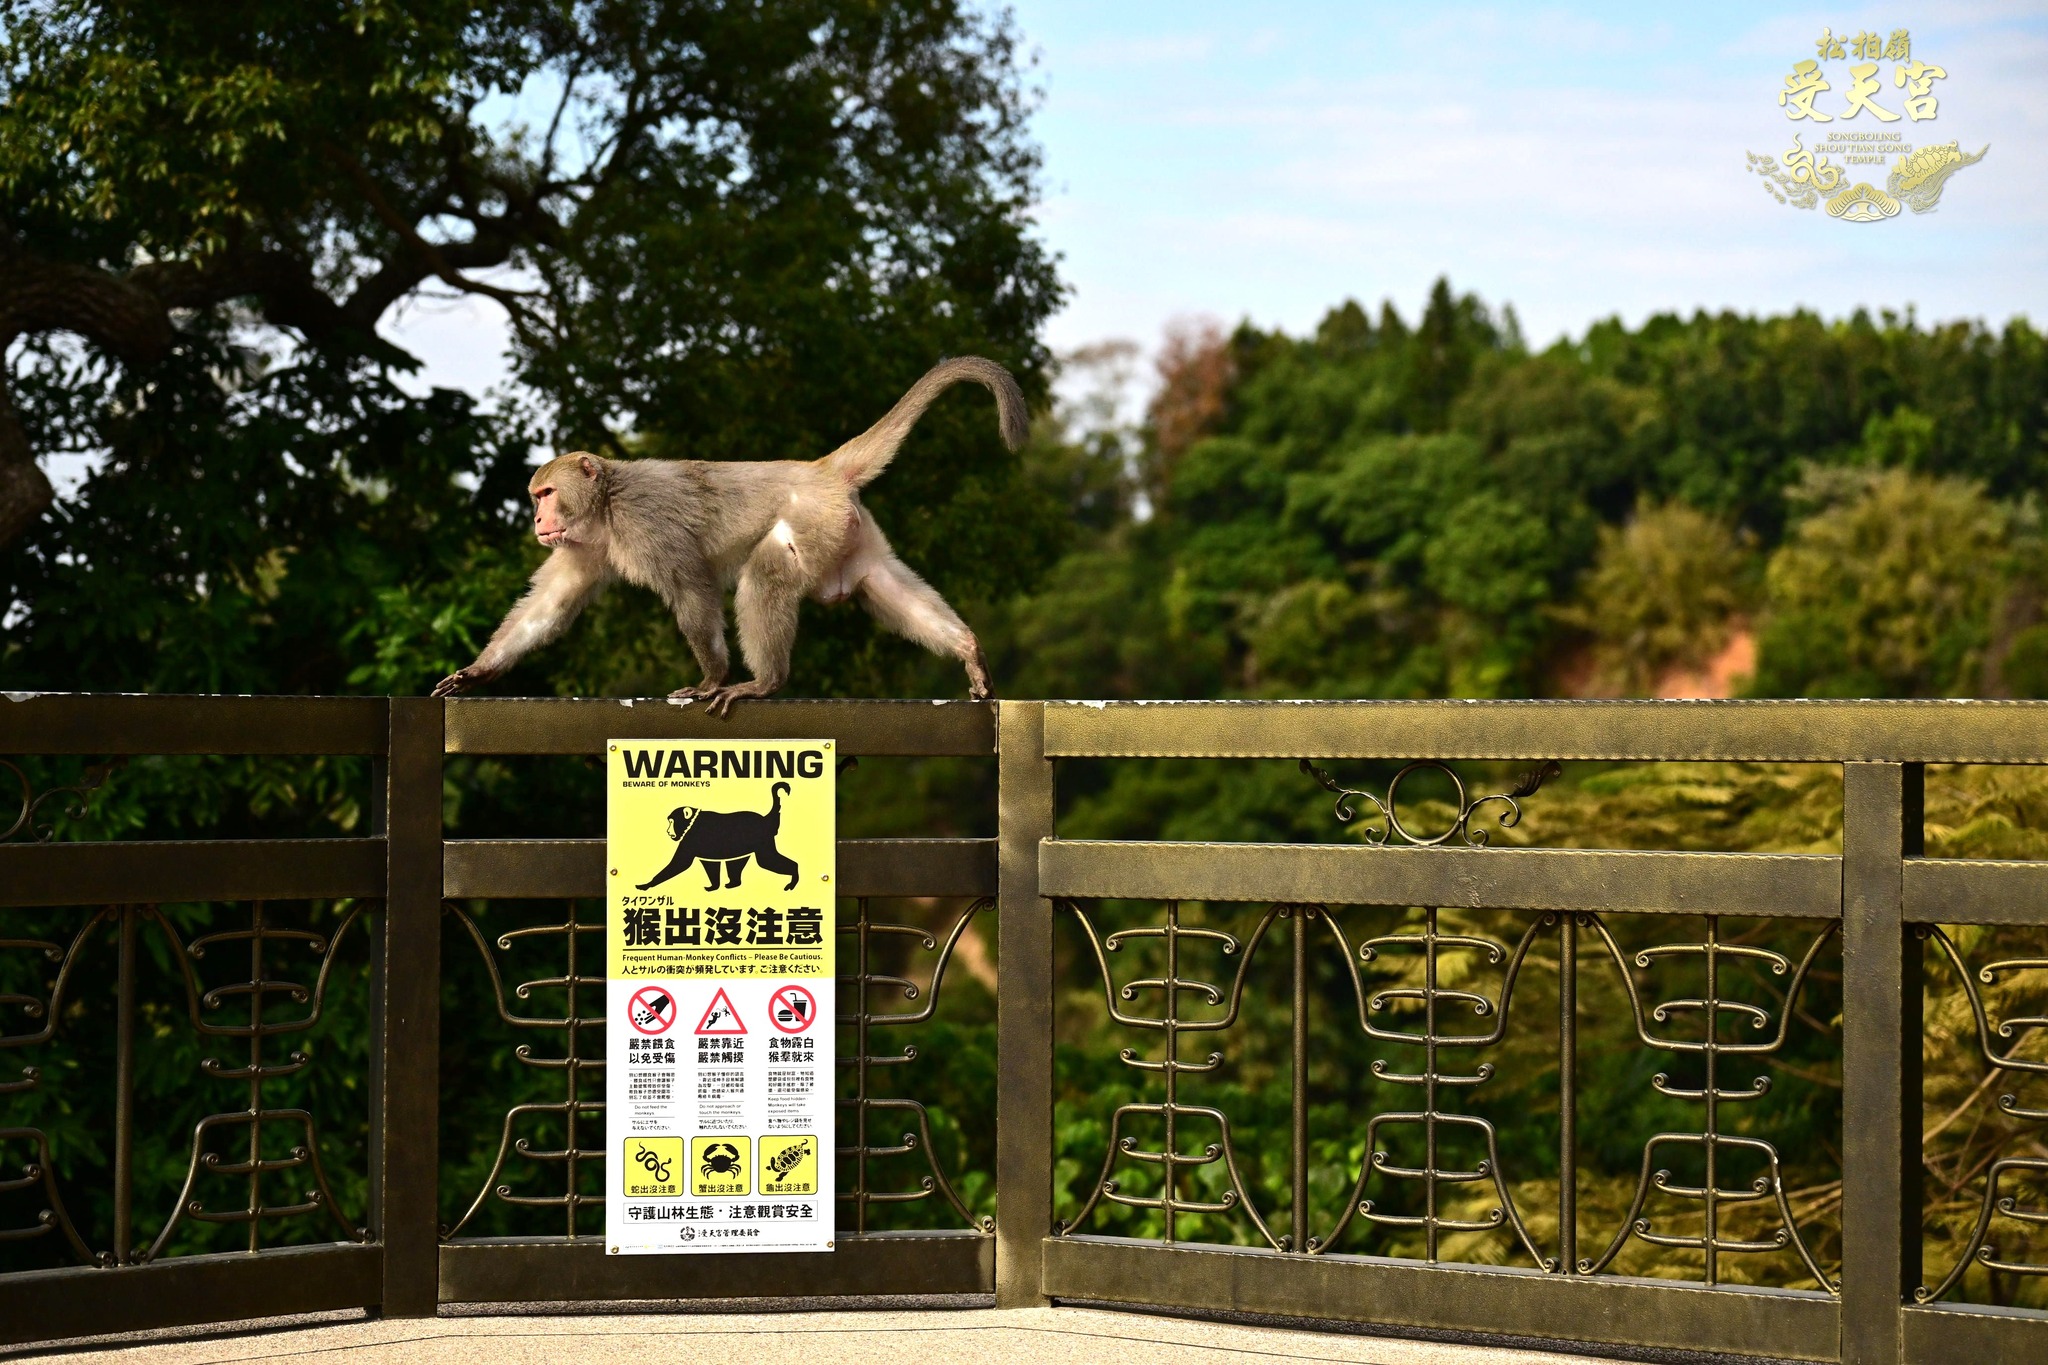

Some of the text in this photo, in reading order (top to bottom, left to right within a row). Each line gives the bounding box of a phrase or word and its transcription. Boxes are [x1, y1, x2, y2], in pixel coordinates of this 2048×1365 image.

[623, 750, 823, 778] WARNING
[622, 895, 674, 906] タイワンザル
[623, 907, 823, 946] 猴出沒注意
[657, 954, 714, 962] Human-Monkey
[629, 1038, 674, 1050] 嚴禁餵食
[698, 1038, 744, 1049] 嚴禁靠近
[769, 1037, 813, 1048] 食物露白
[629, 1052, 675, 1064] 以免受傷
[698, 1052, 743, 1063] 嚴禁觸摸
[631, 1185, 675, 1194] 蛇出沒注意
[699, 1184, 743, 1193] 蟹出沒注意
